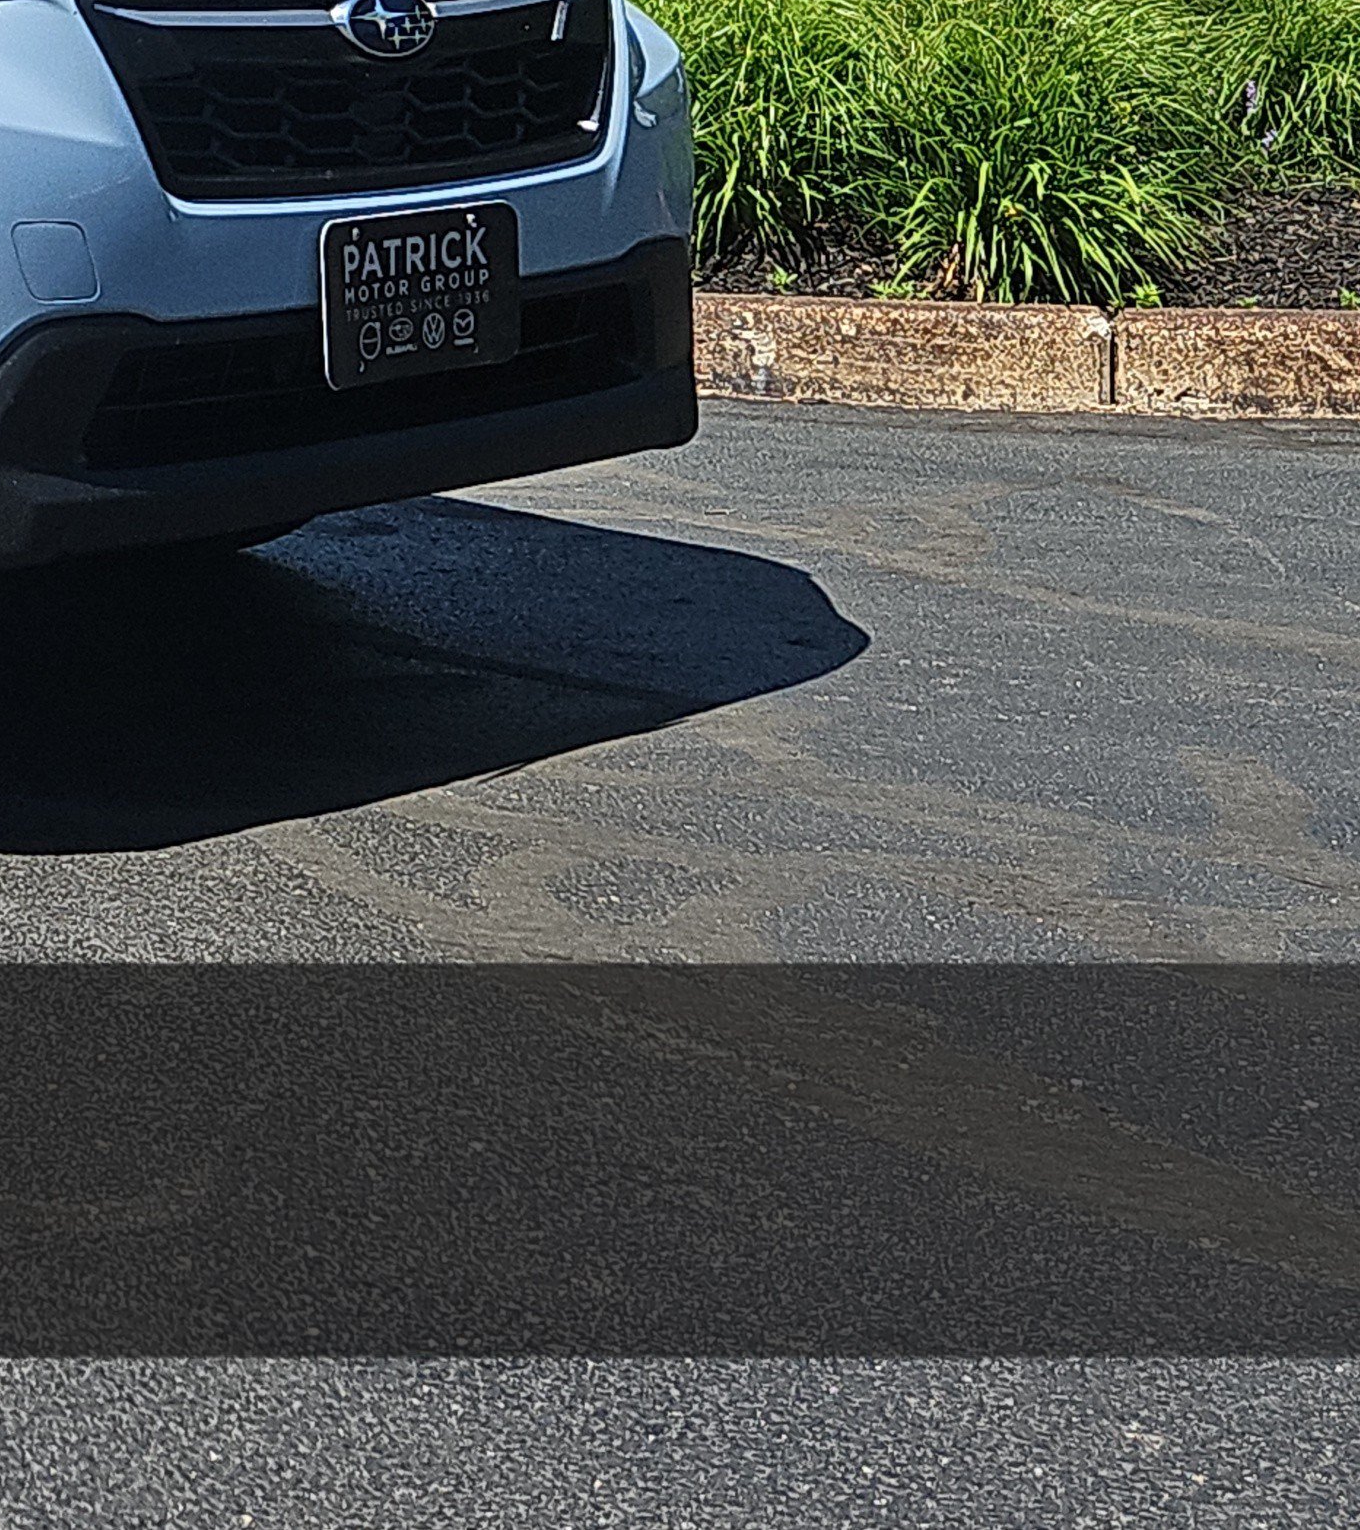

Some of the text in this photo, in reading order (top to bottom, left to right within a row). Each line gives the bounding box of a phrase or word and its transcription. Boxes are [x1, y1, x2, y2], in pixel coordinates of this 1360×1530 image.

[343, 227, 488, 283] PATRICK
[345, 269, 490, 305] MOTOR GROUP
[346, 301, 403, 322] TRUSTED
[411, 294, 450, 313] SINCE
